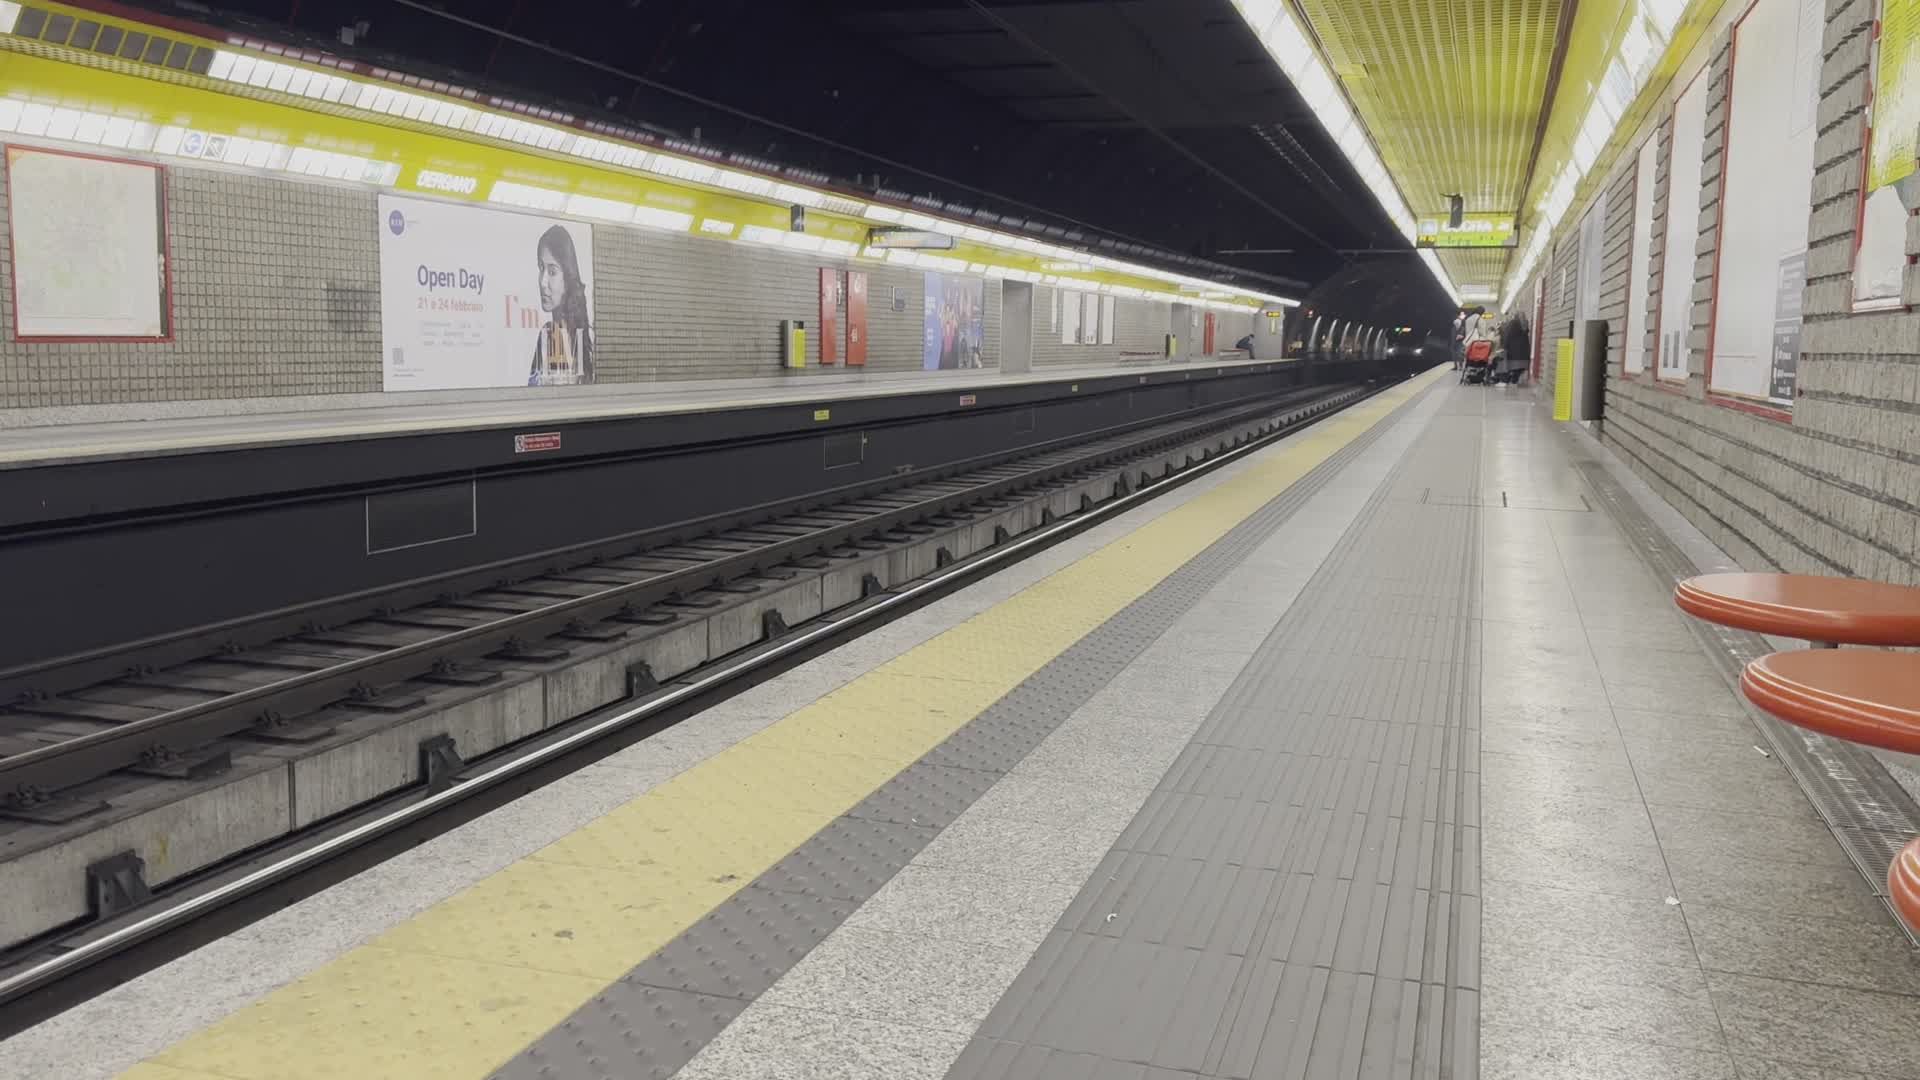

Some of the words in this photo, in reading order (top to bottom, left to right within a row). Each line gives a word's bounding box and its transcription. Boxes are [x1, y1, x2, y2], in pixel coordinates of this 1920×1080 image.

[417, 264, 456, 292] Open
[459, 268, 485, 295] Day
[504, 295, 540, 328] I'm
